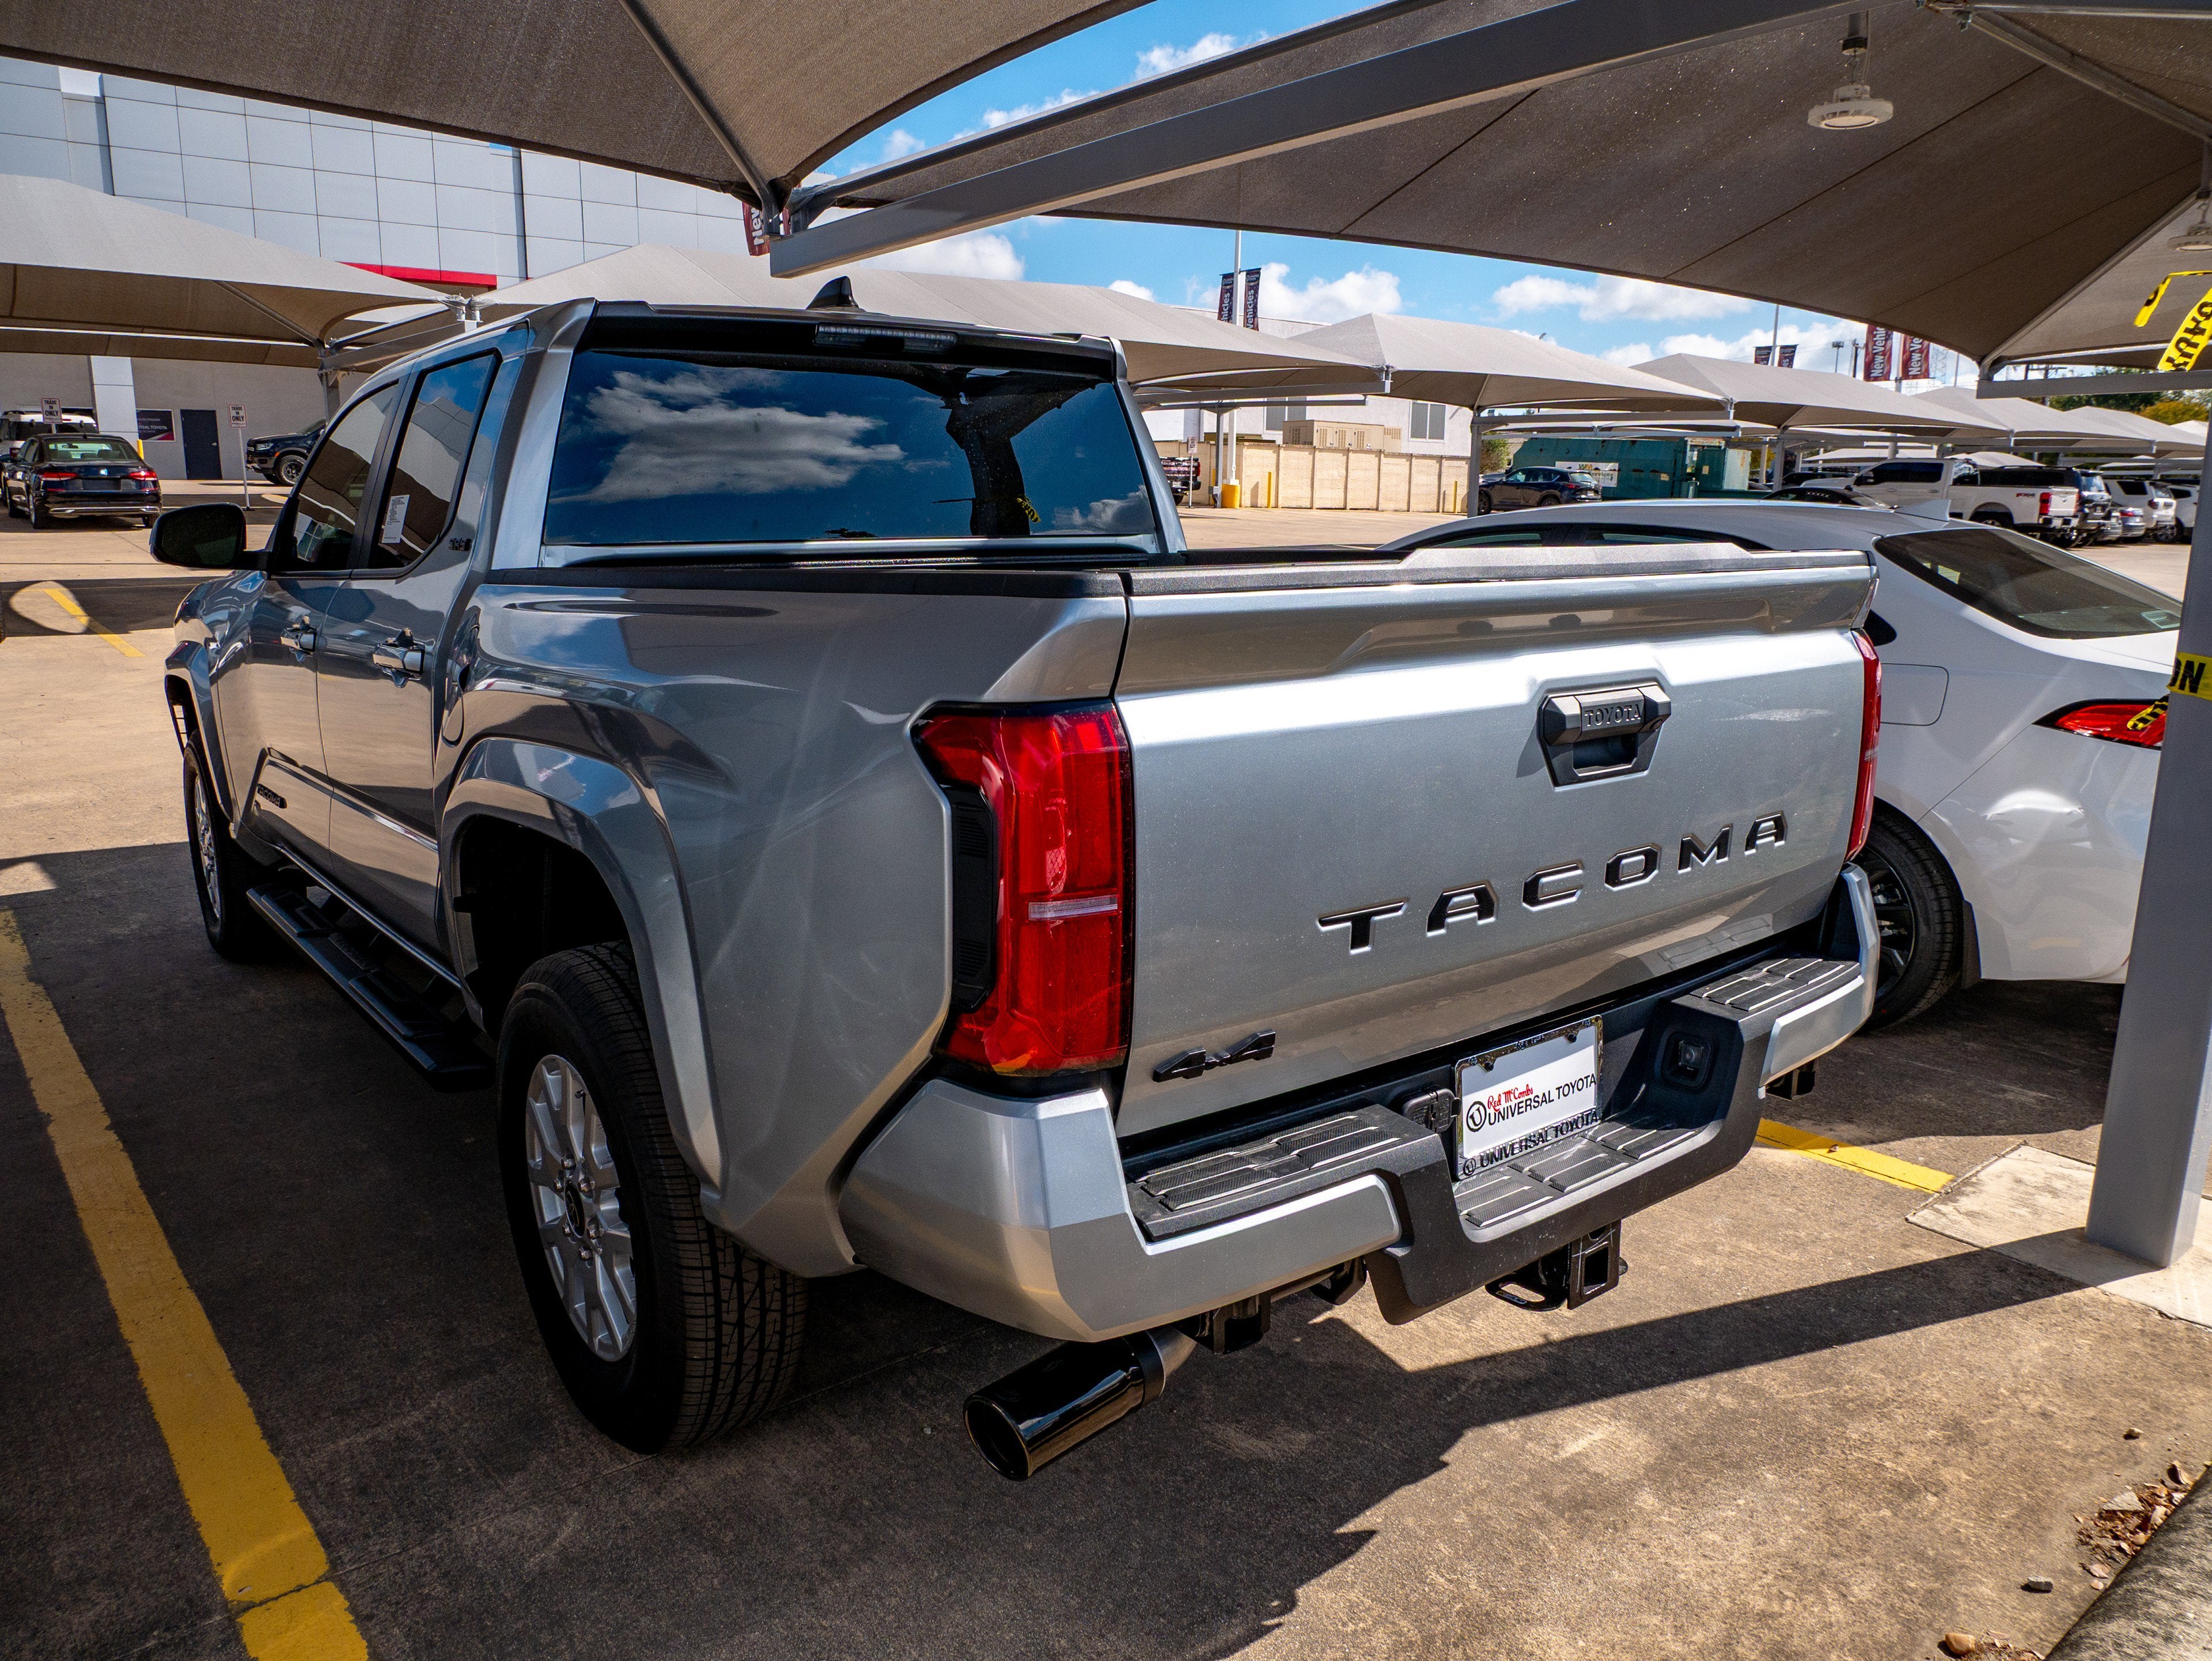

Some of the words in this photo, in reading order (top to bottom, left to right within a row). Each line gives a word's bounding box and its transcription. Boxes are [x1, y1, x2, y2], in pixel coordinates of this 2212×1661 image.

[1221, 293, 1230, 322] hicles
[1246, 289, 1254, 329] Vehicles
[1870, 355, 1884, 377] New
[1908, 353, 1922, 376] New
[1584, 703, 1642, 728] TOYOTA
[1317, 810, 1788, 955] TACOMA
[1487, 1094, 1502, 1112] Red
[1488, 1090, 1555, 1126] UNIVERSAL
[1555, 1072, 1597, 1099] TOYOTA
[1479, 1128, 1552, 1168] UNIVERSAL
[1554, 1109, 1599, 1138] TOYOTA
